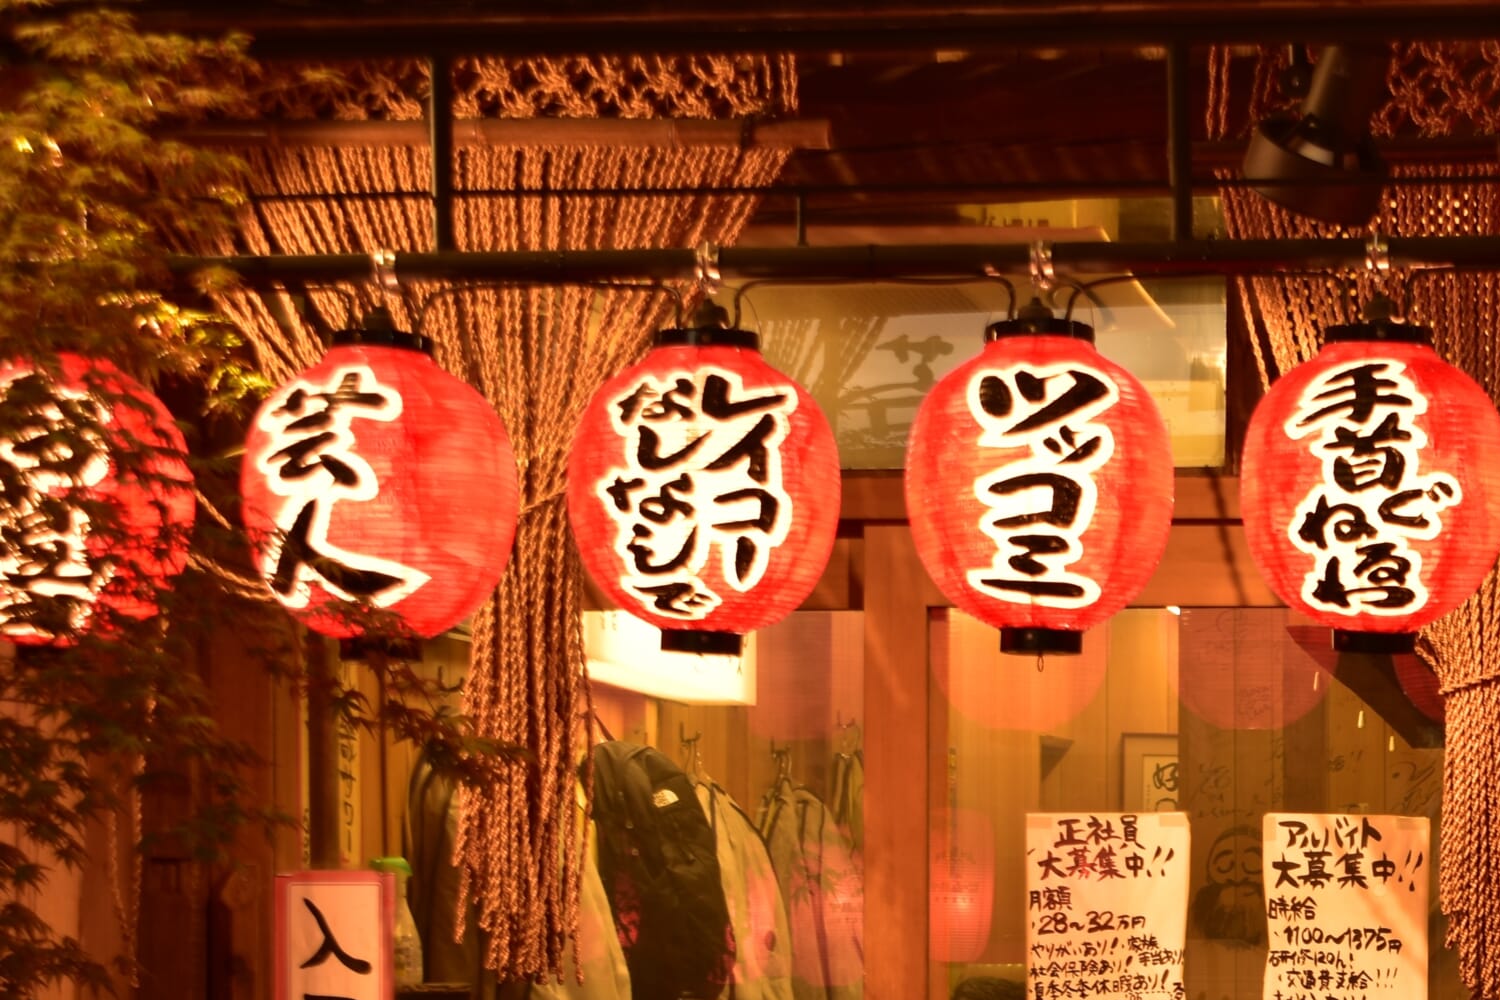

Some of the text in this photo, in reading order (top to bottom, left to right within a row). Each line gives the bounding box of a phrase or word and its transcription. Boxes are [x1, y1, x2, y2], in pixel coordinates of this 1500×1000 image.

[266, 371, 406, 602] 芸人
[701, 374, 790, 584] レイコー
[978, 370, 1109, 598] ツッコミ
[1054, 815, 1145, 849] 正社員
[1277, 817, 1383, 848] アルバイト
[1267, 896, 1318, 922] 時給
